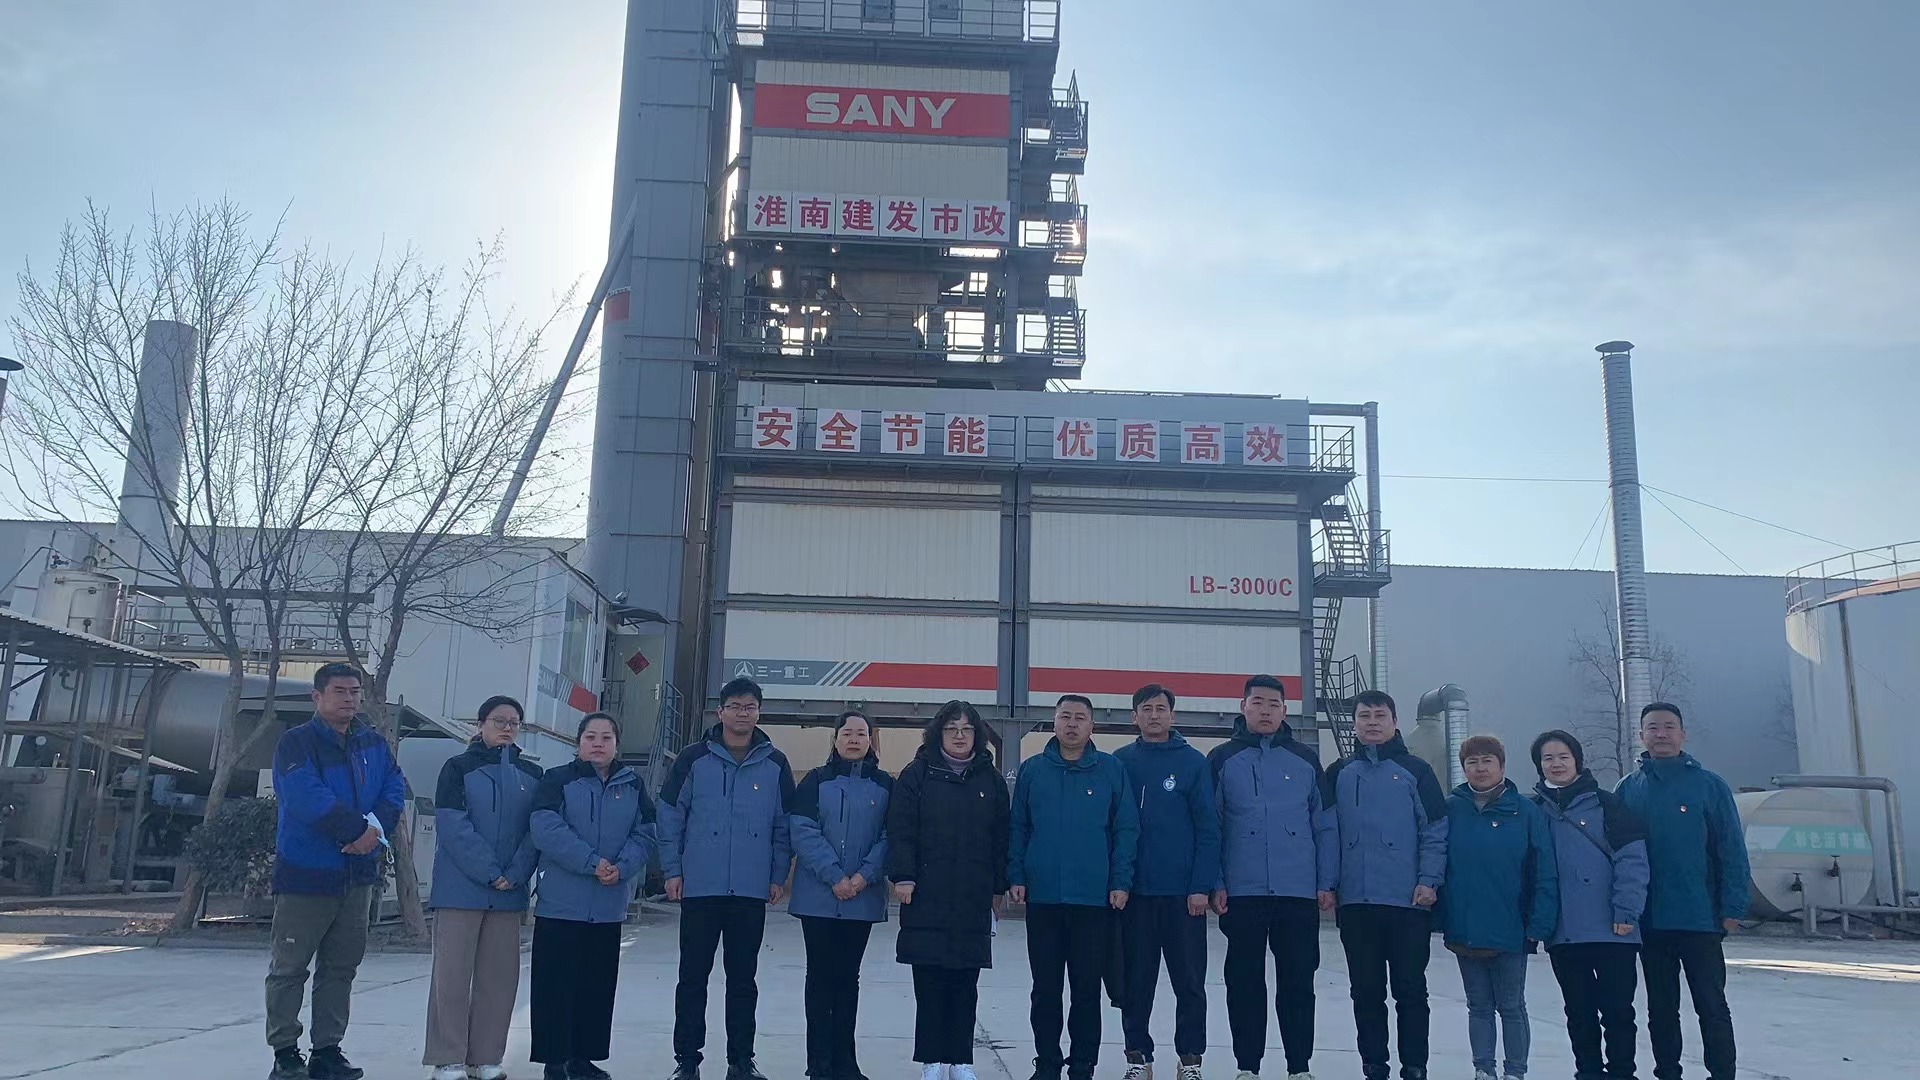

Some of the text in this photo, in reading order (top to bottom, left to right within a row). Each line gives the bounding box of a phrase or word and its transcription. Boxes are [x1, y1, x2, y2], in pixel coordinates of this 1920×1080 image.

[806, 91, 956, 129] SANY
[754, 195, 1007, 236] 淮南建发市政
[756, 407, 1284, 463] 安全节能 优质高效
[1189, 575, 1292, 597] LB-3000C
[756, 665, 810, 679] 三一重工
